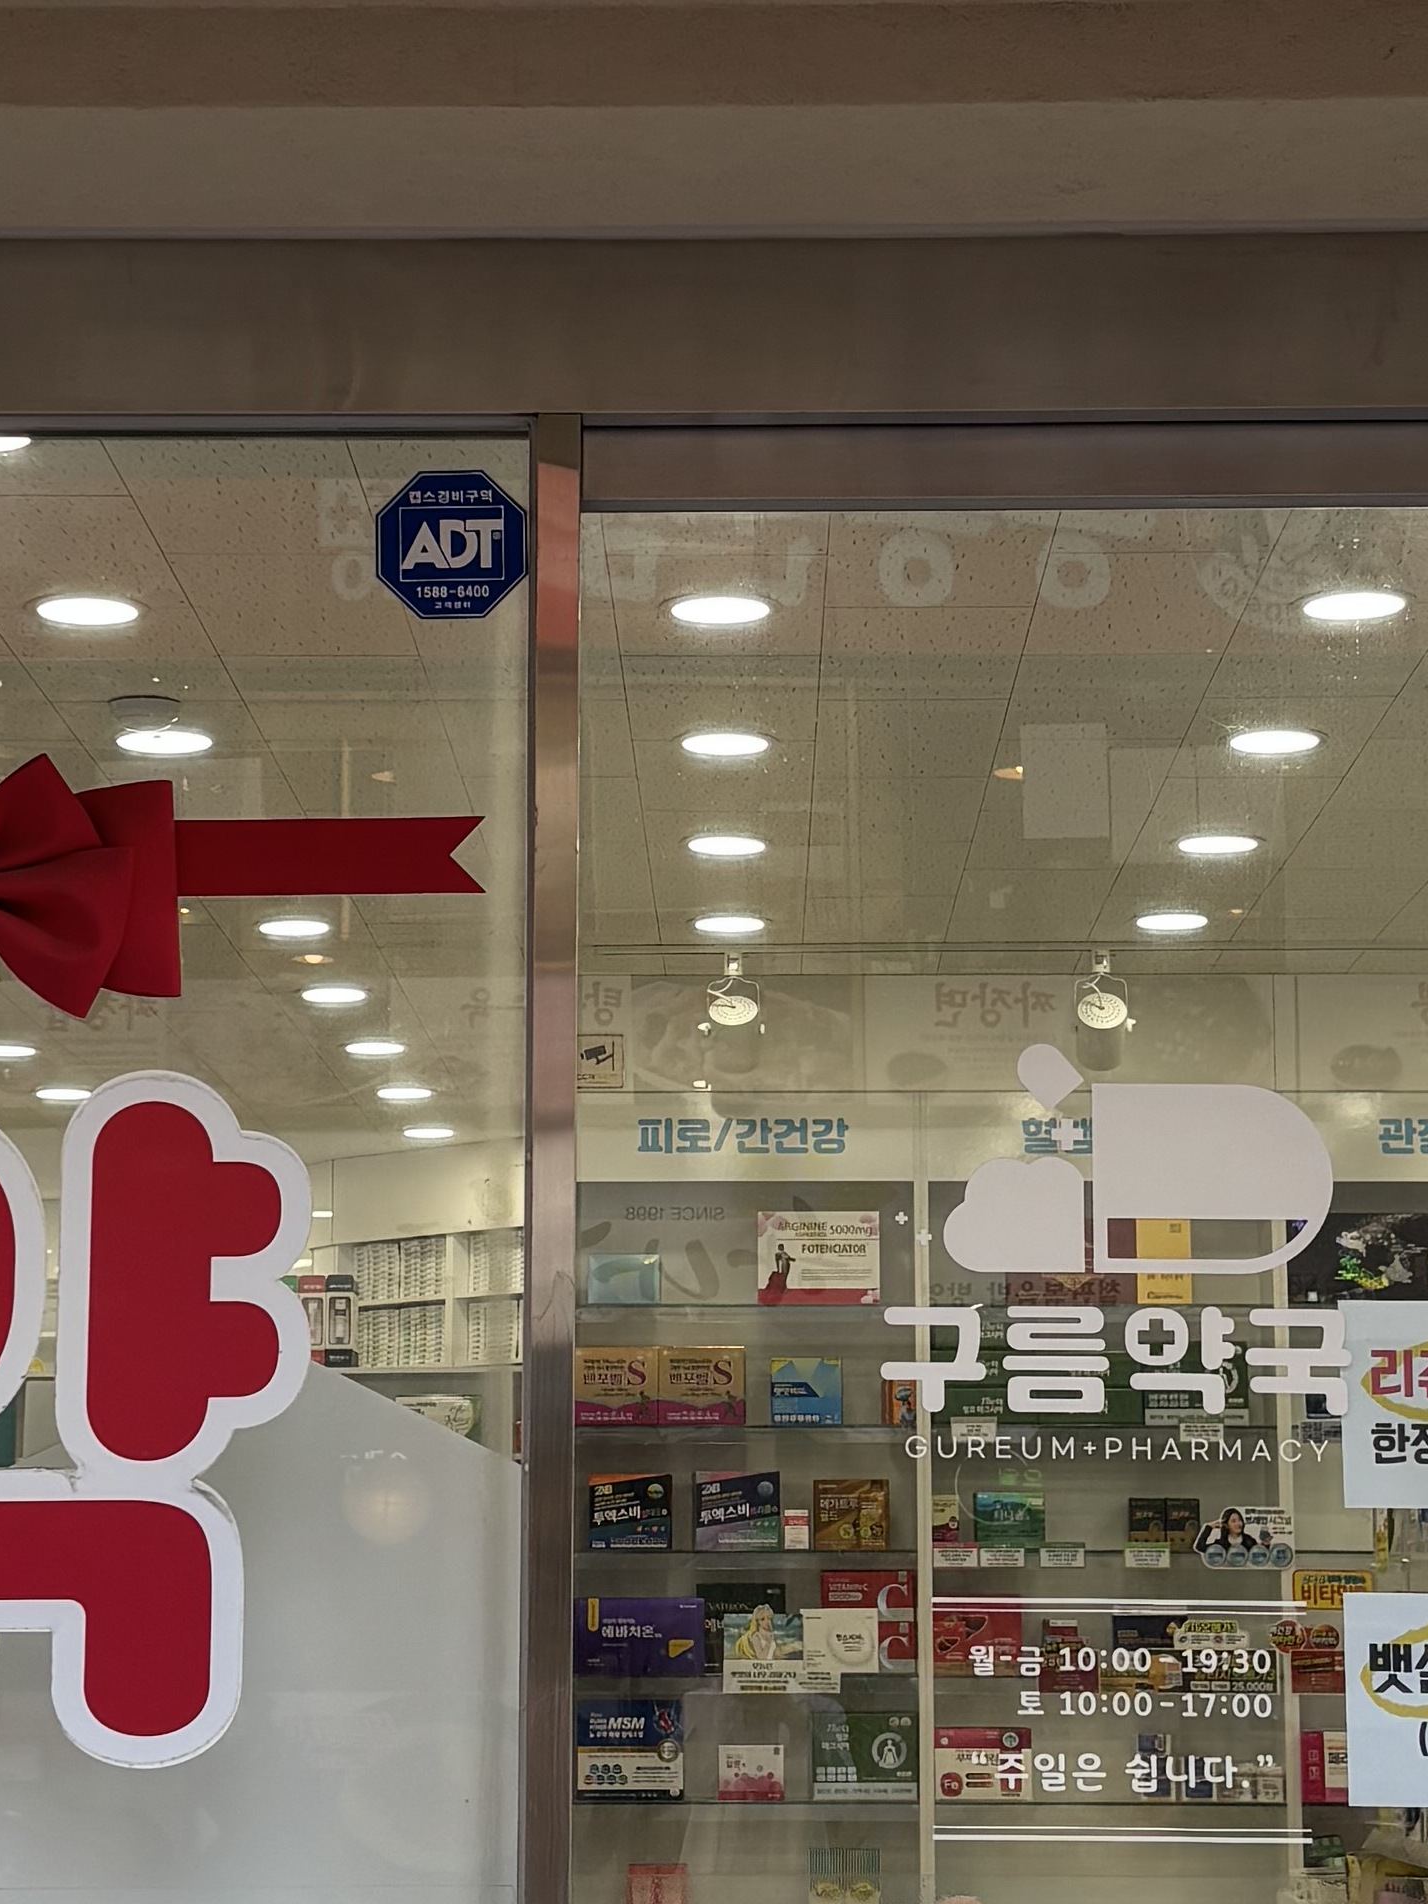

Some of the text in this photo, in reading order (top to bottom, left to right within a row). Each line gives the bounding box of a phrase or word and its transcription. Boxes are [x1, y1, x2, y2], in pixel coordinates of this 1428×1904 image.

[401, 518, 503, 570] ADT
[416, 584, 490, 599] 1588-6400
[637, 1117, 850, 1156] 피로/간건강
[879, 1304, 1353, 1415] 구름약국
[904, 1435, 1330, 1463] GUREUM+PHARMACY
[1017, 1691, 1045, 1715] 토
[607, 1717, 646, 1730] MSM
